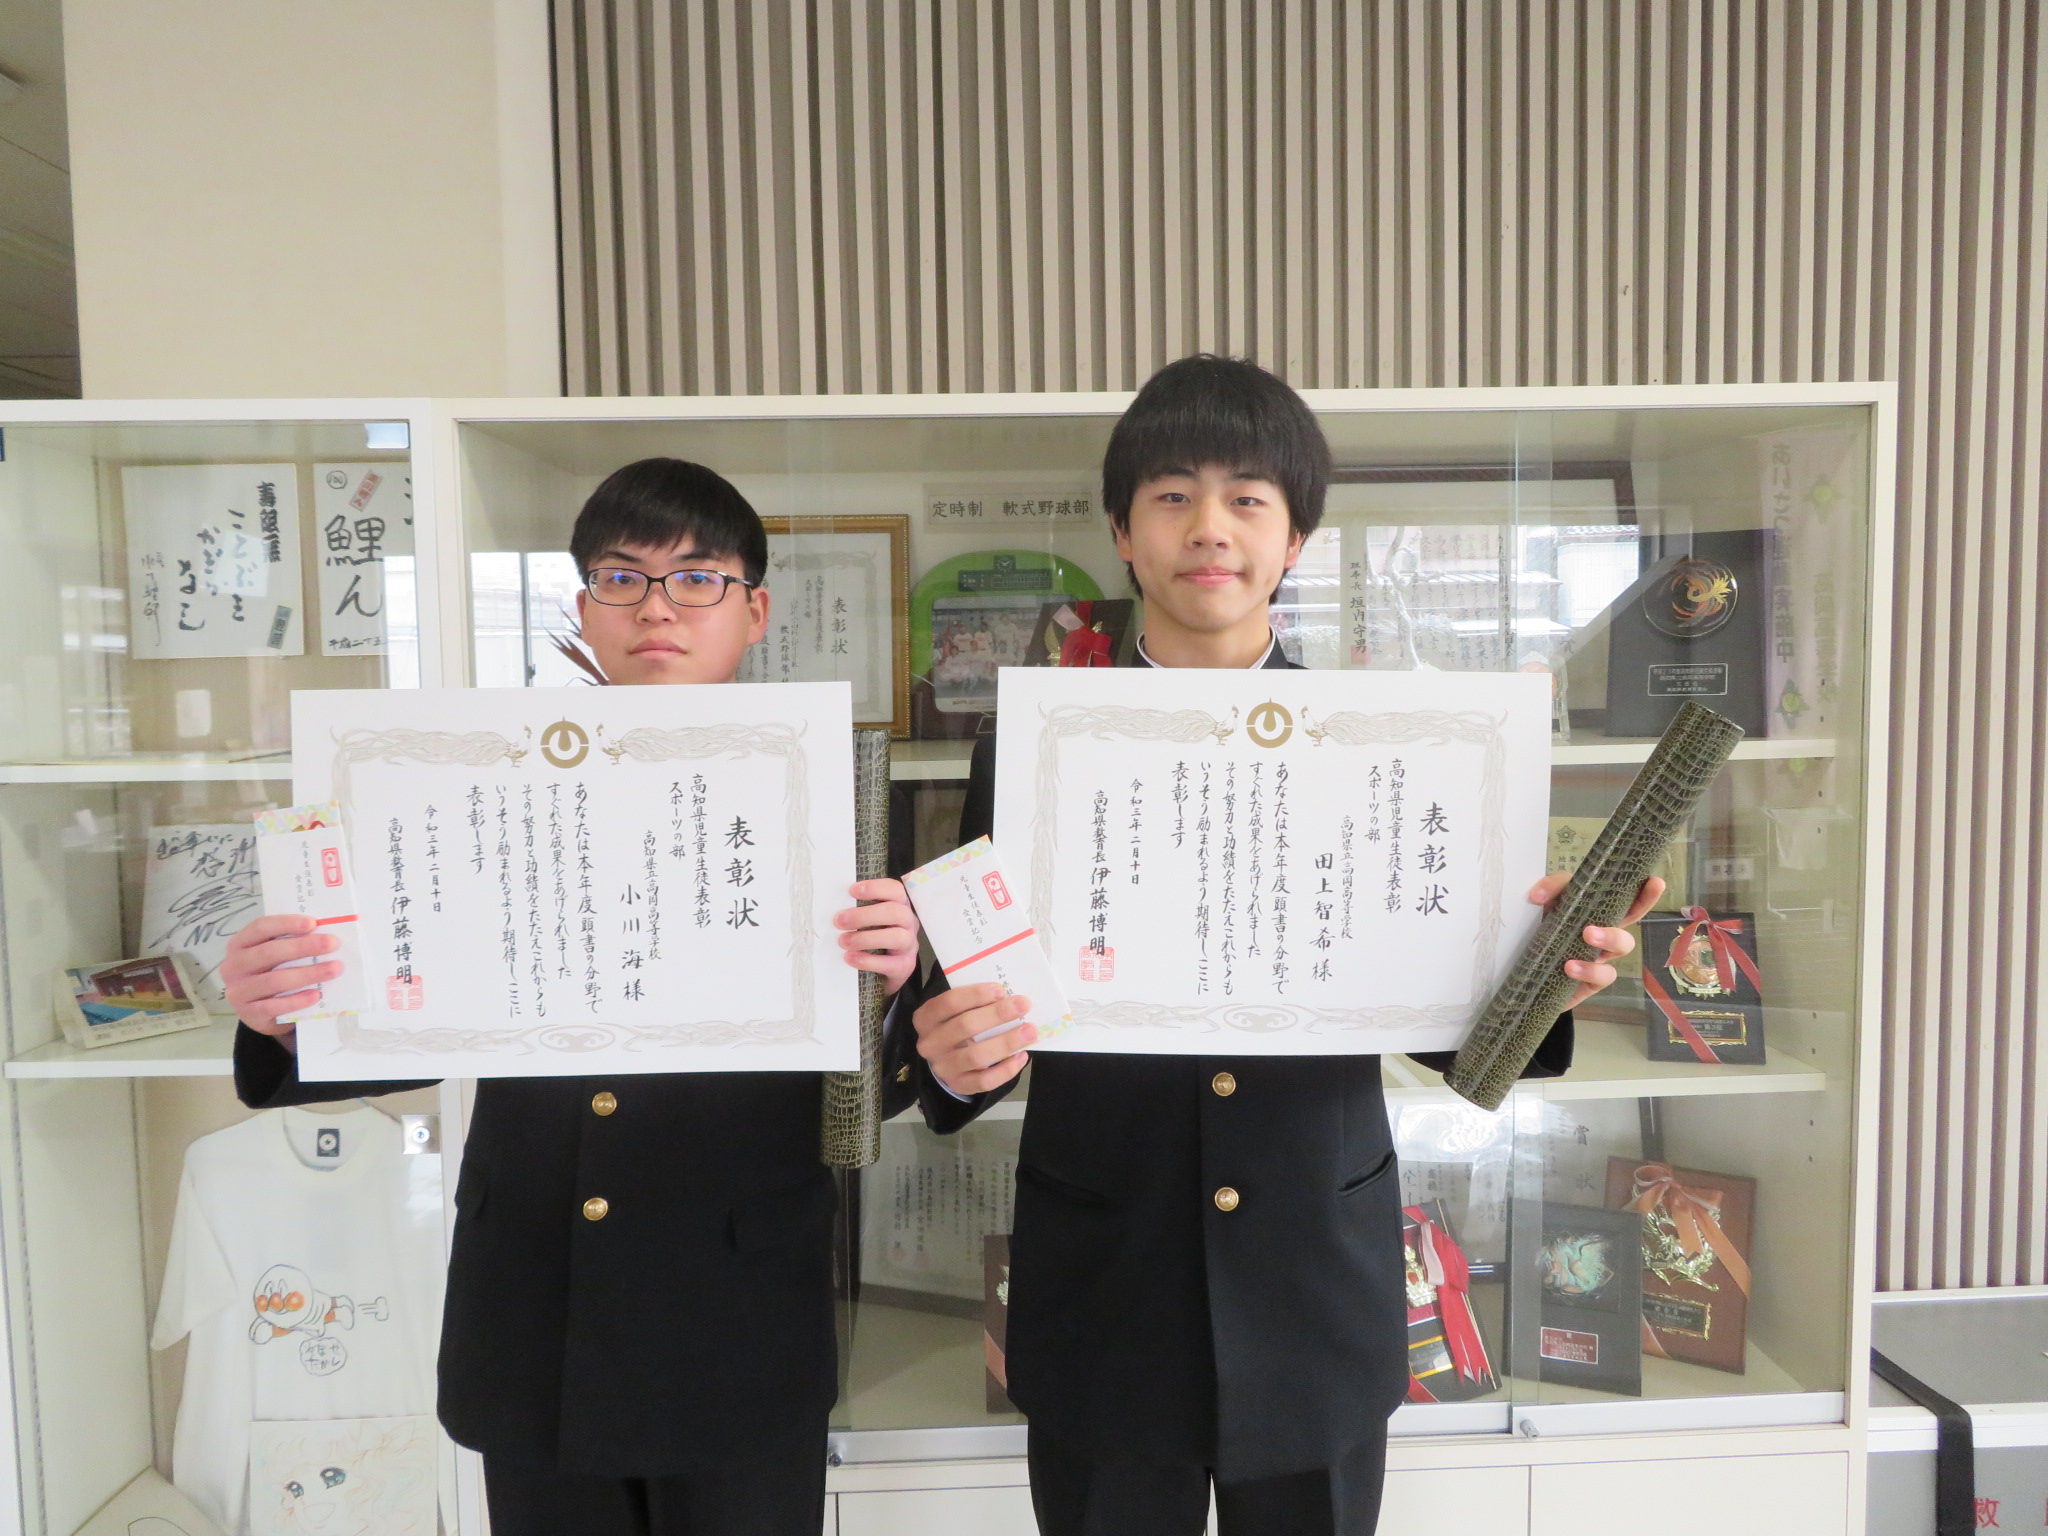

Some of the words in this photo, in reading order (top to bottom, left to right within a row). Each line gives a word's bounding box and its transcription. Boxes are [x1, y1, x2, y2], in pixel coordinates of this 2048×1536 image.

[932, 500, 983, 518] 定時制
[1002, 499, 1090, 517] 軟式野球部
[831, 597, 848, 654] 表彰状
[466, 785, 485, 874] 表彰します
[669, 782, 685, 859] スポーツの部
[690, 774, 711, 928] 高知県児童生徒表彰
[1171, 761, 1189, 848] 表彰します
[1247, 762, 1263, 958] すぐれた成果をあげられました
[1365, 766, 1381, 843] スポーツの部
[1384, 758, 1405, 913] 高知県児童生徒表彰
[1416, 802, 1449, 916] 表彰状
[521, 784, 546, 1017] その努力と功績をたたえこれからも
[547, 783, 571, 979] すぐれた成果をあげられました
[575, 782, 602, 1013] あなたは本年度頭書の分野で
[724, 815, 759, 929] 表彰状
[1221, 762, 1236, 995] その努力と功績をたたえこれからも
[1272, 762, 1290, 994] あなたは本年度頭書の分野で
[1310, 853, 1335, 981] 田上智希様
[621, 884, 644, 1001] 小川海様
